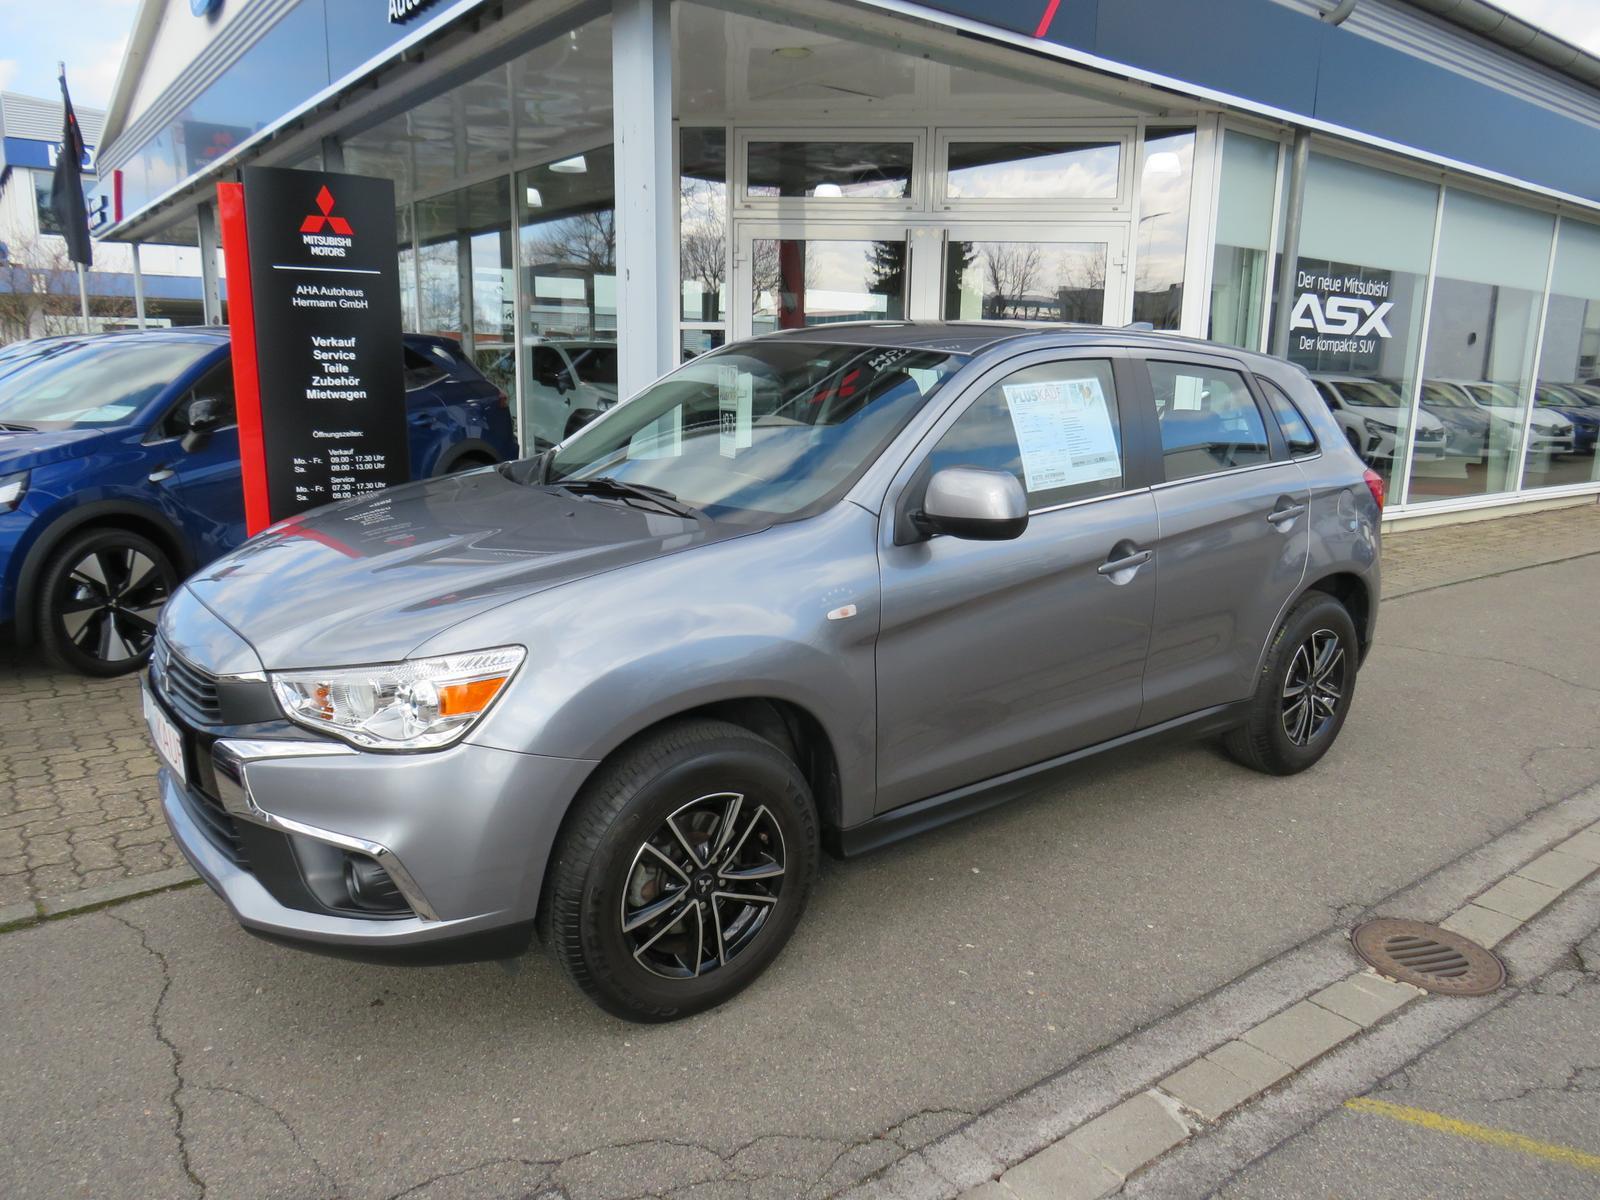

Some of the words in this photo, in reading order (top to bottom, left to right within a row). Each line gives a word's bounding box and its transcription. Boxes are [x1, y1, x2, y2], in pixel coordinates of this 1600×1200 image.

[303, 235, 352, 247] MITSUBISHI
[311, 247, 346, 257] MOTORS
[1298, 271, 1315, 288] Der
[1317, 277, 1341, 292] neue
[1344, 277, 1389, 297] Mitsubishi
[296, 286, 319, 295] AHA
[320, 286, 364, 297] Autohaus
[292, 298, 337, 308] Hermann
[339, 299, 368, 309] GmbH
[1290, 293, 1395, 338] ASX
[312, 336, 356, 347] Verkauf
[1299, 336, 1315, 350] Der
[1317, 338, 1357, 355] kompakte
[1359, 340, 1375, 353] SUV
[313, 350, 356, 360] Service
[322, 363, 349, 373] Teile
[312, 376, 360, 387] Zubehör
[306, 389, 367, 401] Mietwagen
[328, 448, 354, 456] Verkauf
[330, 476, 355, 484] Service
[332, 491, 352, 499] 09.00
